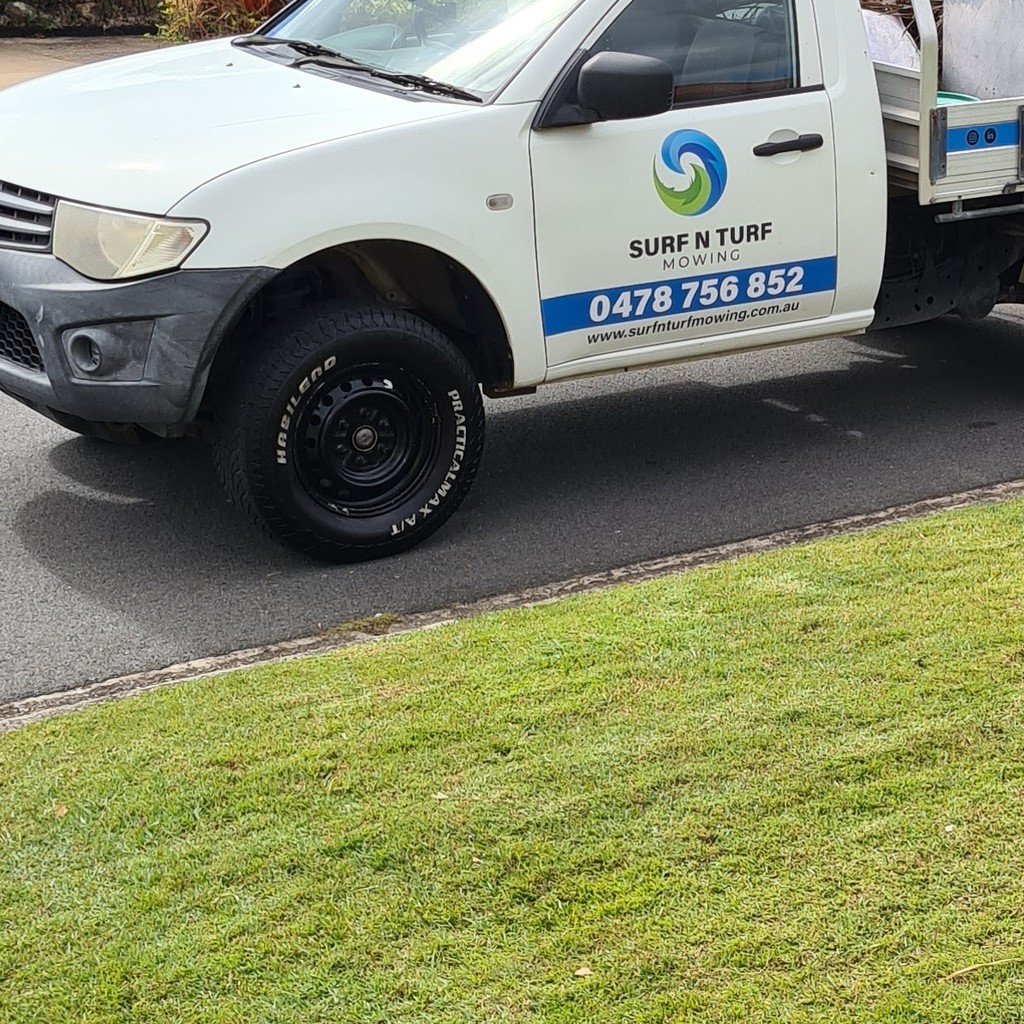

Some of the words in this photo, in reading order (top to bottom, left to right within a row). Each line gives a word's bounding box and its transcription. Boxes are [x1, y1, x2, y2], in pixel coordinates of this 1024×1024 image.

[629, 232, 690, 259] SURF
[696, 230, 710, 250] N
[715, 222, 773, 247] TURF
[662, 249, 741, 271] MOWING
[588, 285, 674, 323] 0478
[681, 276, 739, 309] 756
[746, 266, 805, 299] 852
[586, 300, 800, 345] www.surfnturfmowing.com.au
[419, 389, 468, 518] PRACTICALMAX
[390, 514, 417, 536] A/T
